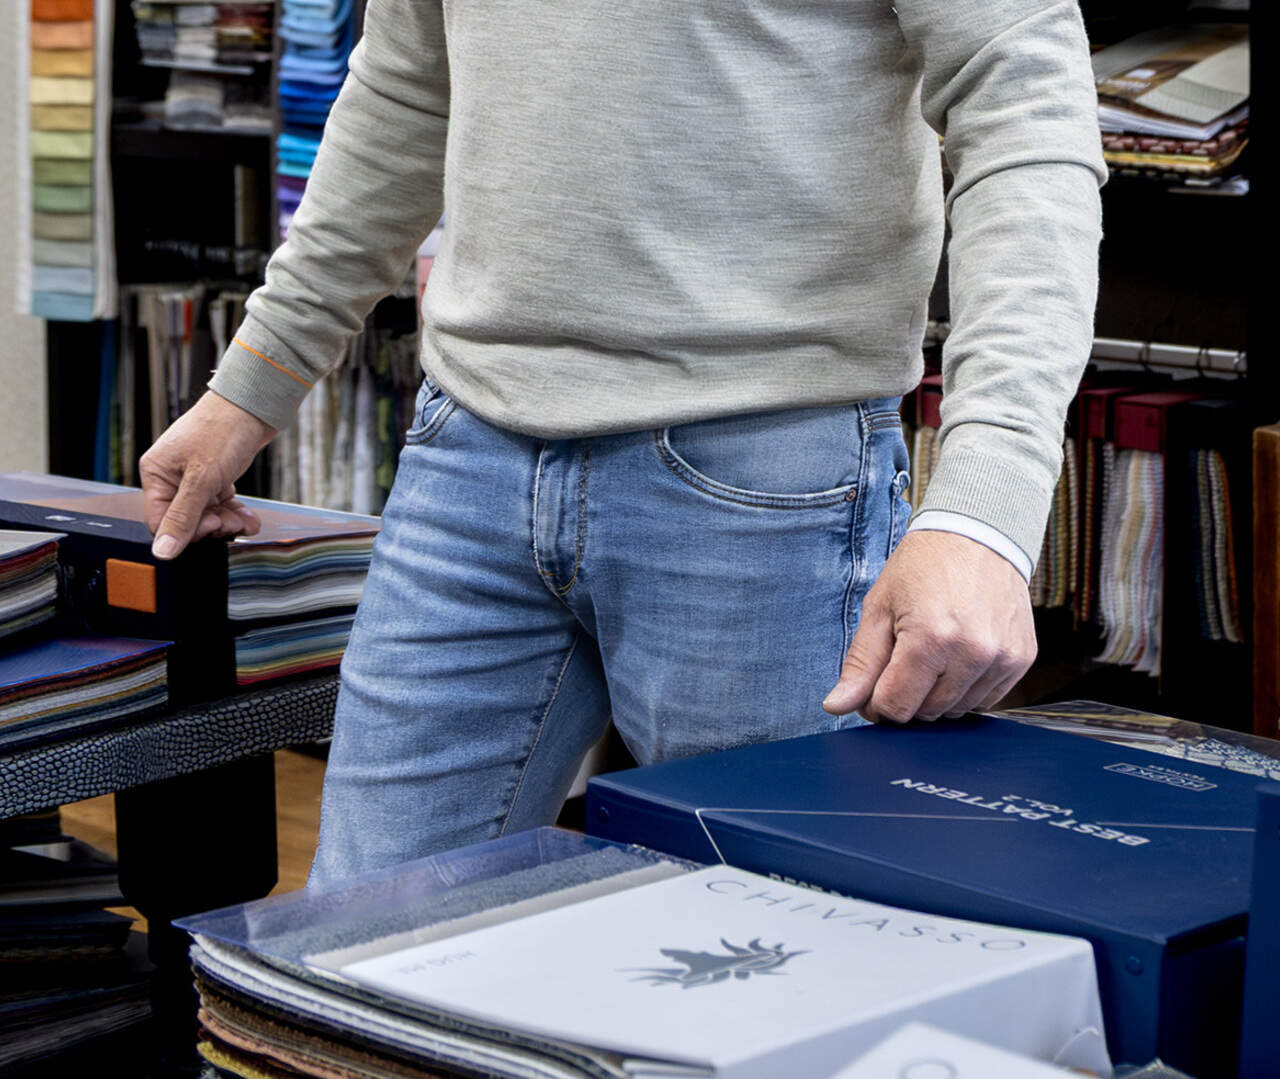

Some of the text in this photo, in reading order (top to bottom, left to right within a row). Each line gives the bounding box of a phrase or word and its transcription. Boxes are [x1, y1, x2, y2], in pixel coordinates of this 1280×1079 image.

[889, 778, 1151, 846] BEST PATTERN
[706, 879, 1026, 951] CHIVASSO
